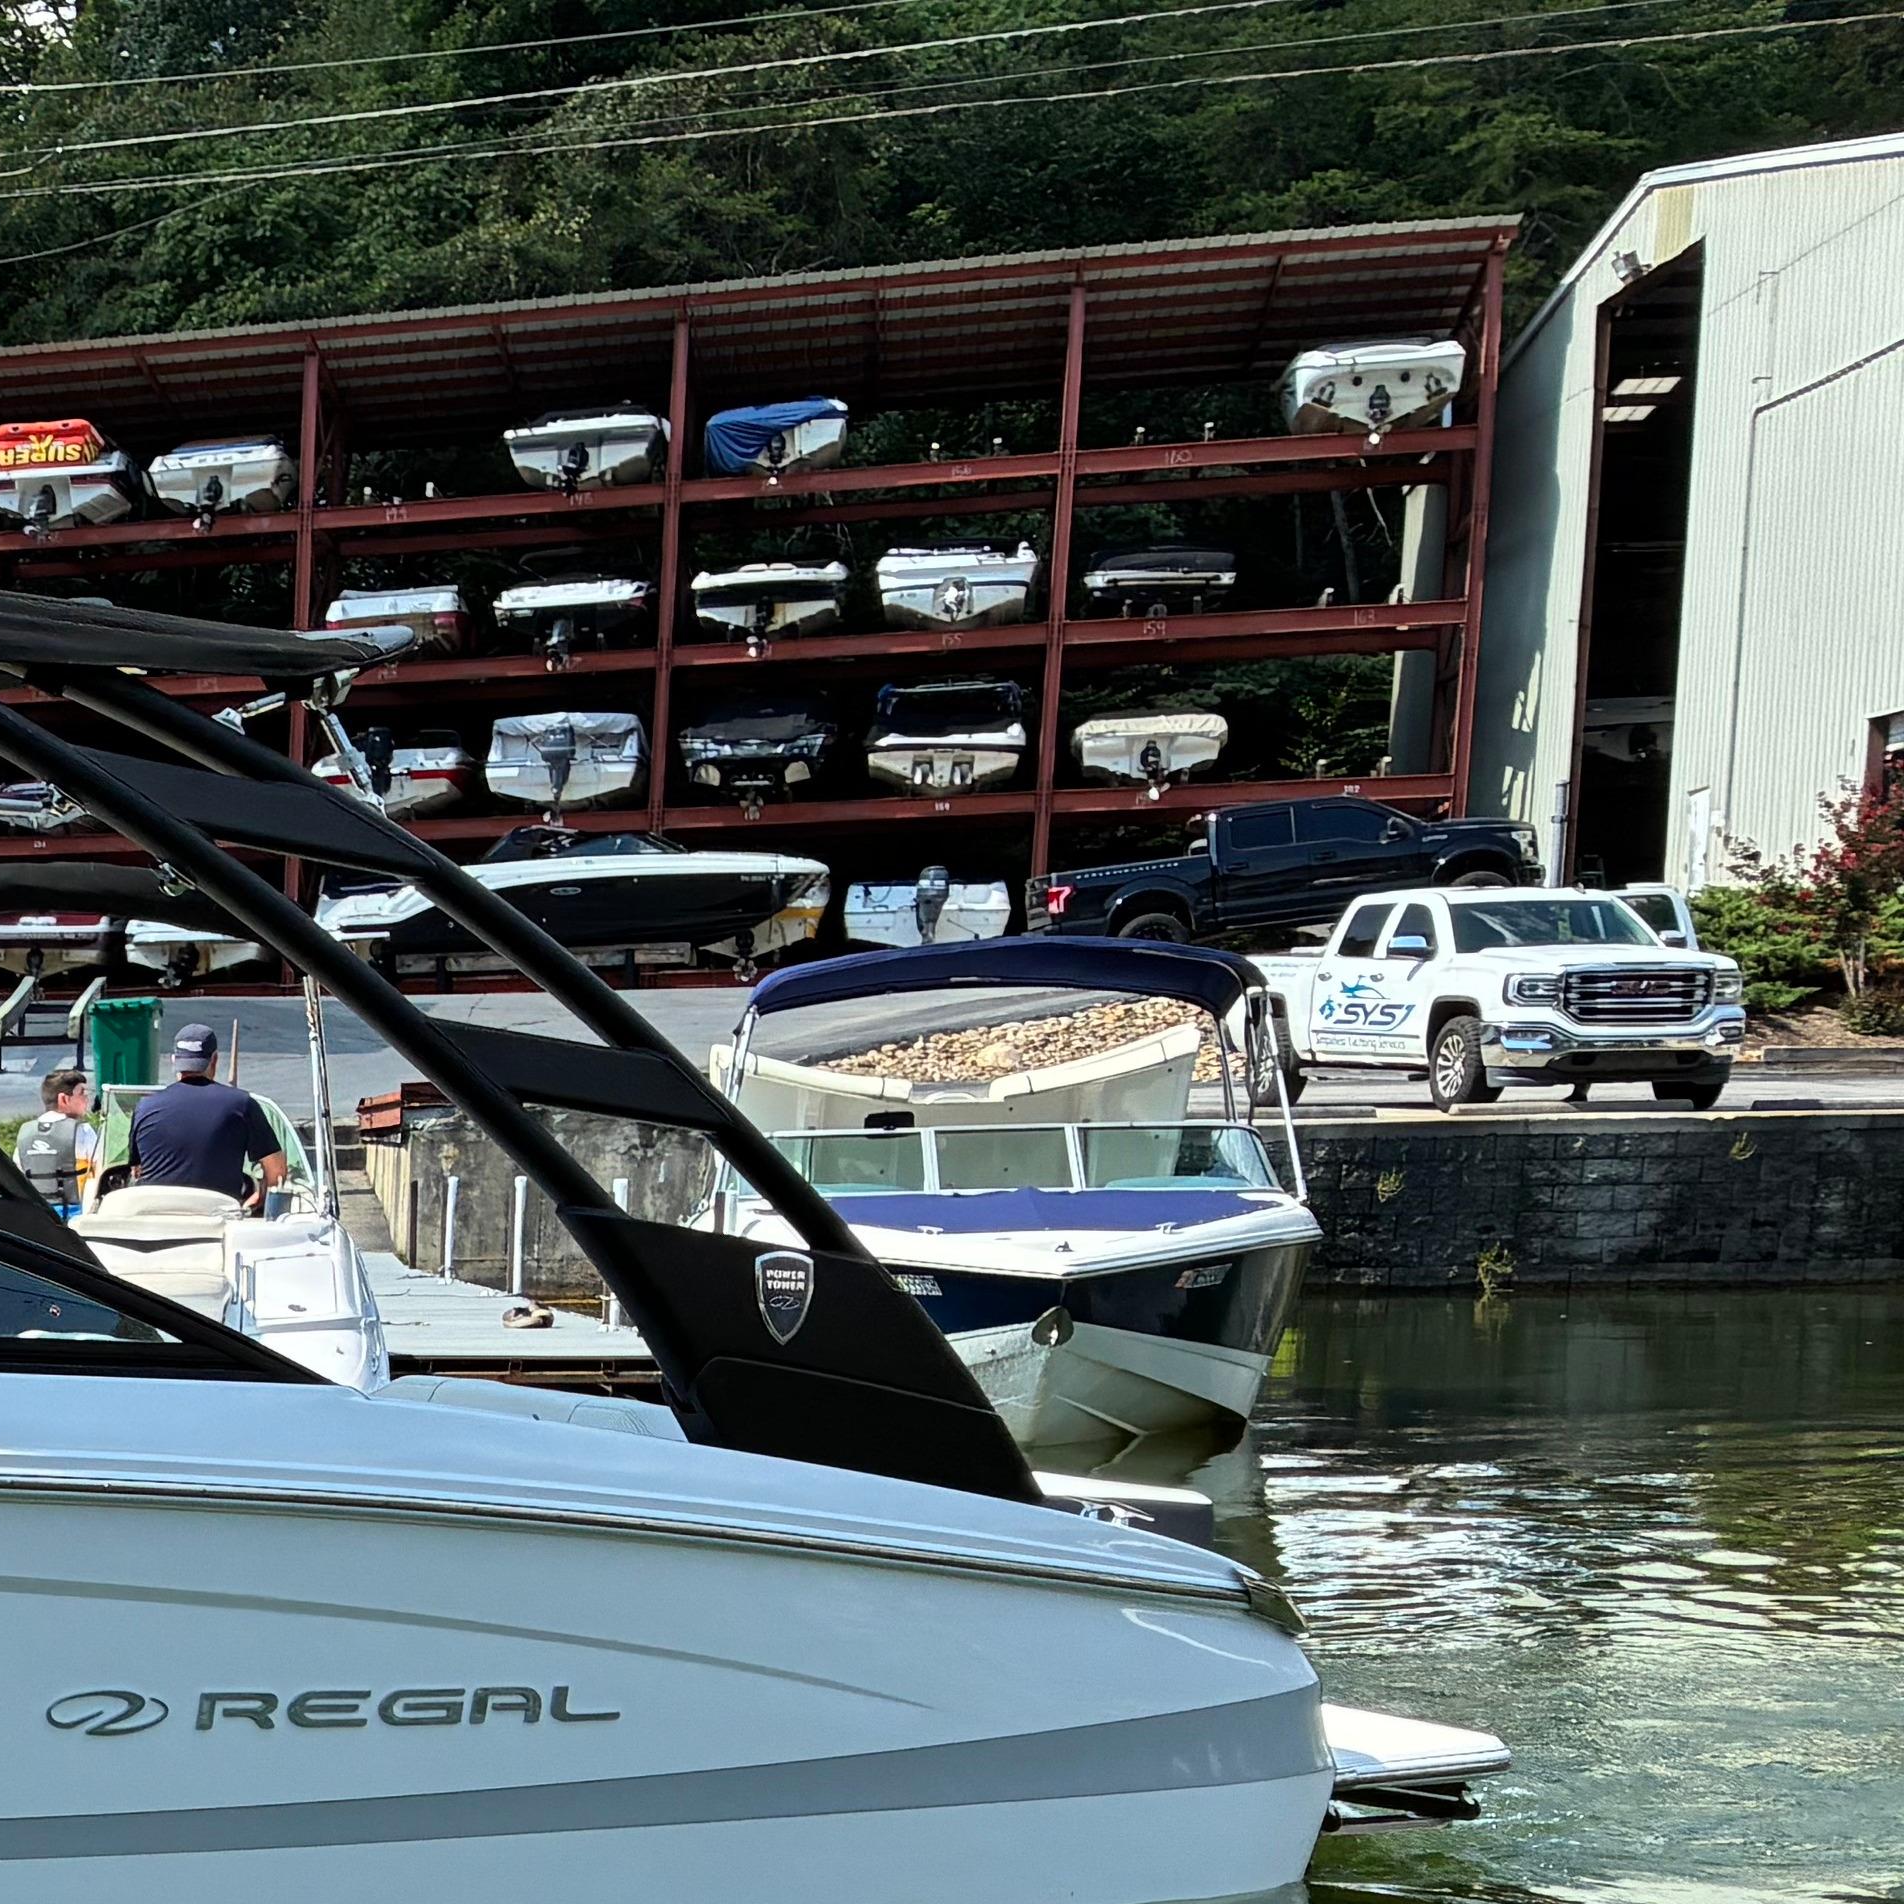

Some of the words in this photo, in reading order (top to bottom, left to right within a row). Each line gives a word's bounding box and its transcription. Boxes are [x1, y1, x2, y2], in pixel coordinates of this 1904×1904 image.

[1143, 620, 1167, 636] 159
[765, 1269, 806, 1280] POWER
[765, 1279, 805, 1291] TOWER
[195, 1685, 621, 1731] REGAL
